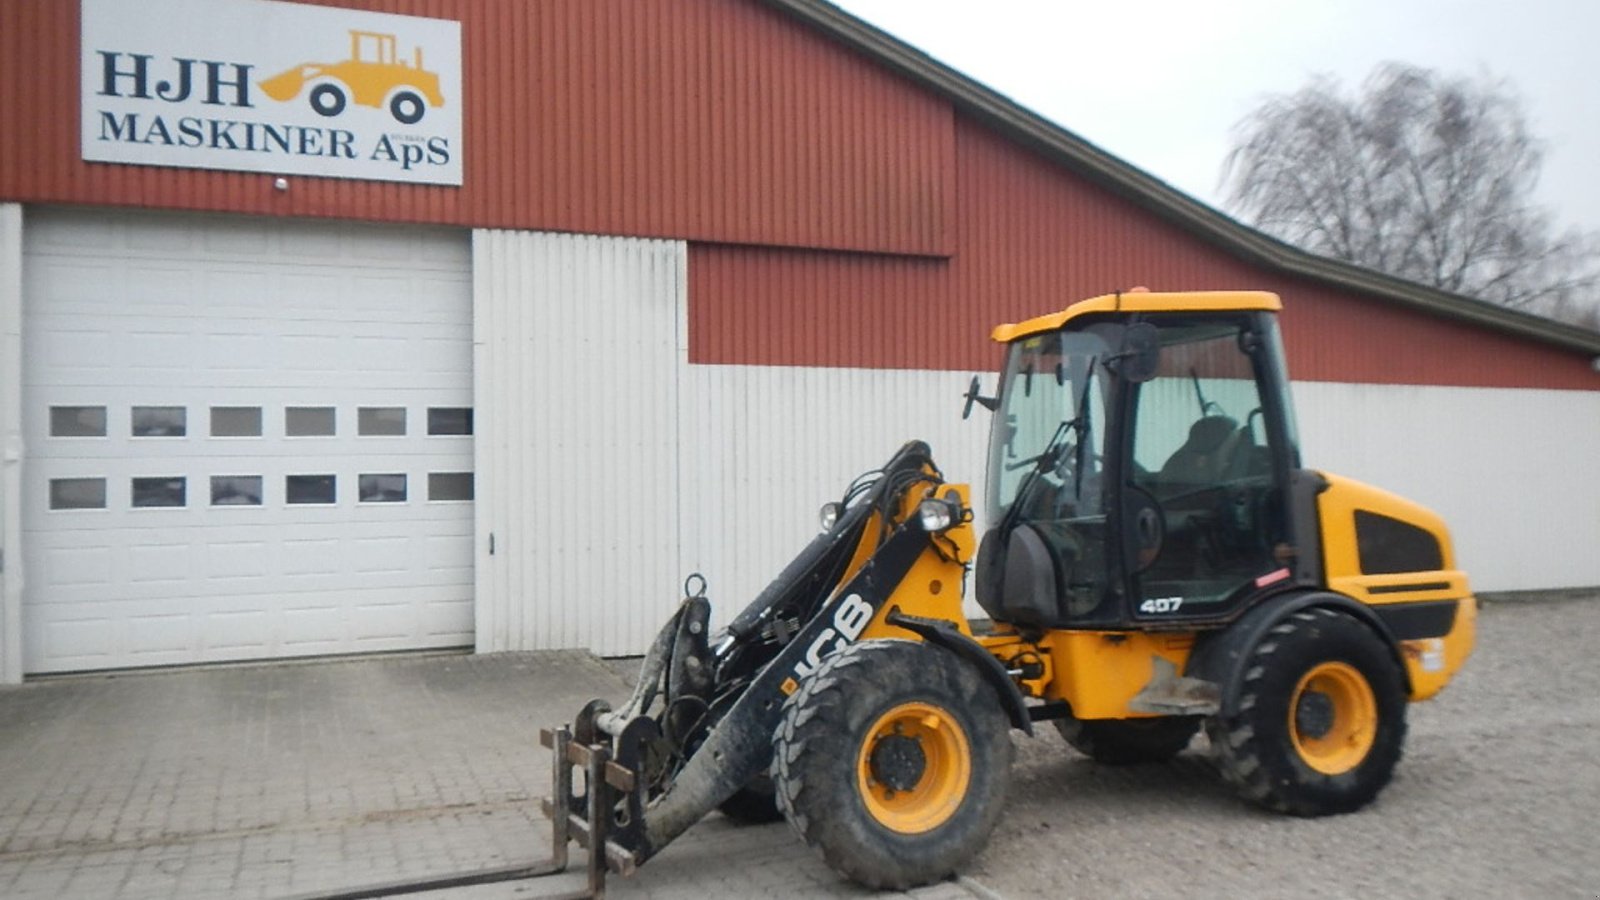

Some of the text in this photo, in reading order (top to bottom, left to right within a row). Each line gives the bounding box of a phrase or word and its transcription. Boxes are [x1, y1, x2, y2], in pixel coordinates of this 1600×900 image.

[96, 50, 255, 108] HJH
[97, 110, 449, 170] MASKINER ApS
[1139, 597, 1183, 613] 407
